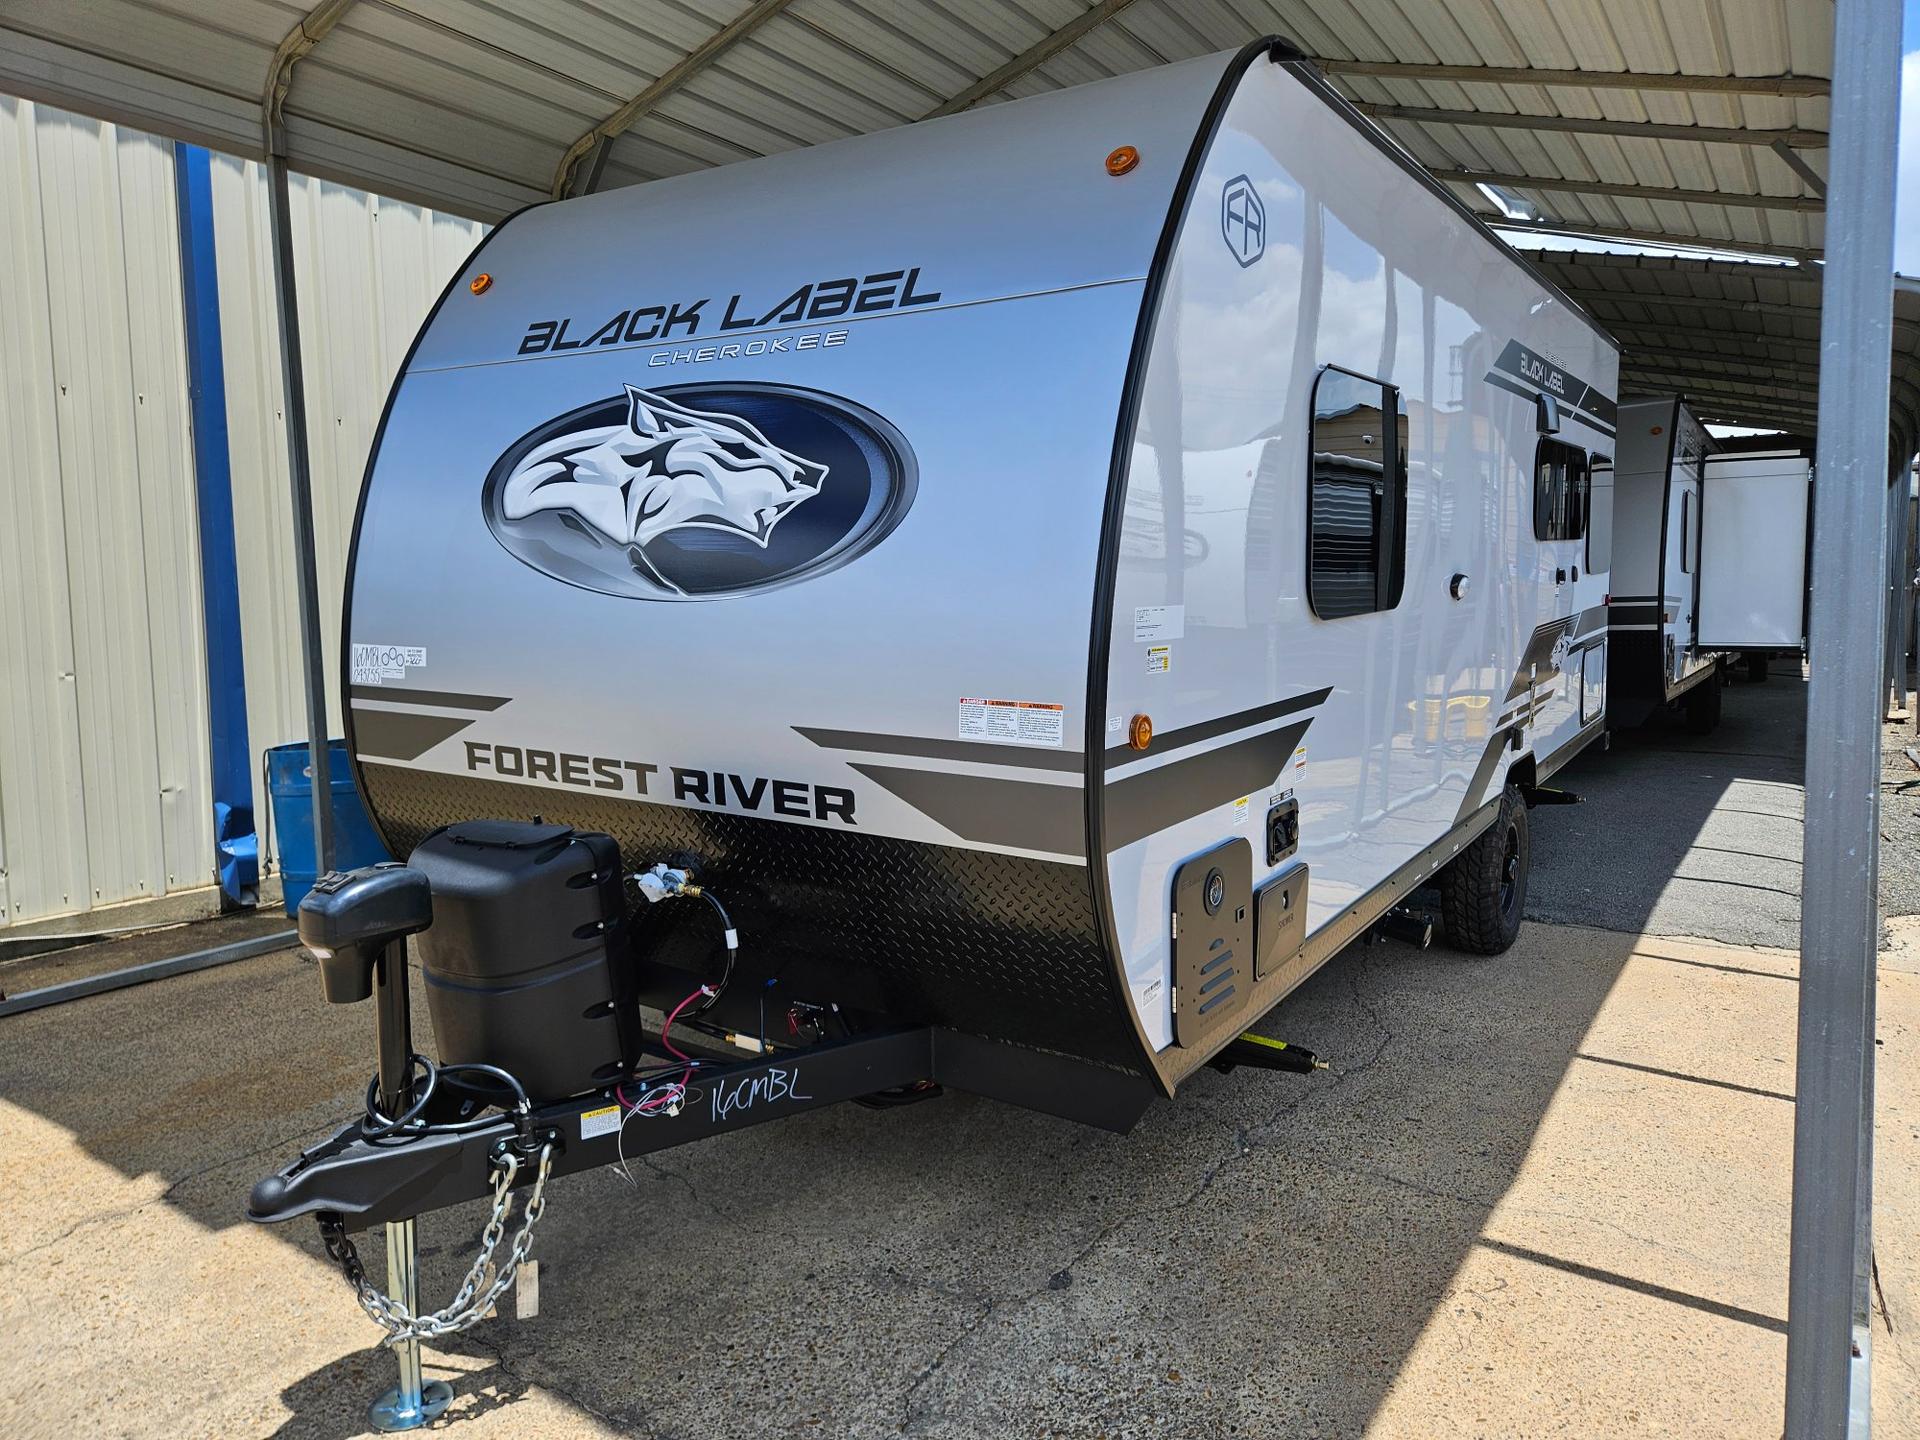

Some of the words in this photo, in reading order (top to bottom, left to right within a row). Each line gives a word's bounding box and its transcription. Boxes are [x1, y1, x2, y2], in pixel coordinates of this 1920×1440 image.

[518, 299, 710, 355] BLACK
[720, 267, 942, 331] LABEL
[648, 329, 849, 368] CHEROKEE
[1521, 352, 1544, 383] BLACK
[1544, 366, 1565, 394] LABEL
[463, 740, 658, 795] FOREST
[669, 766, 858, 826] RIVER
[711, 1068, 813, 1123] 16CMBL
